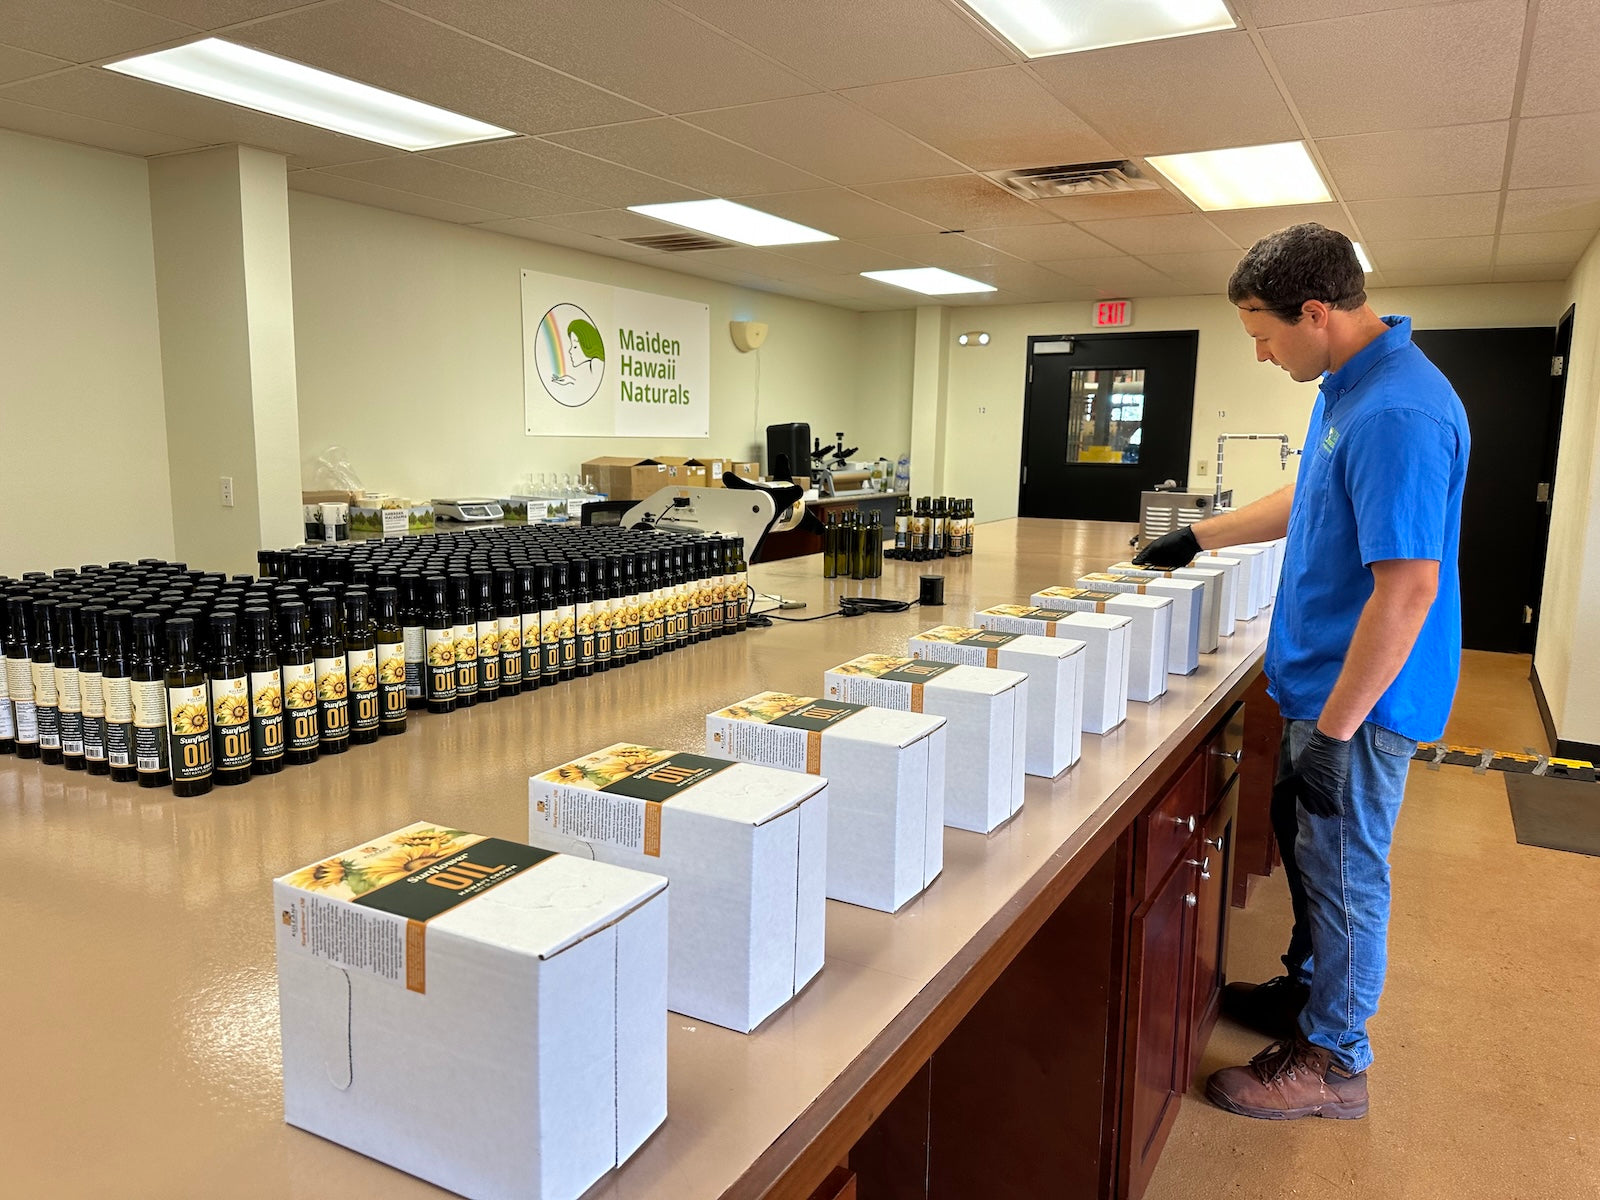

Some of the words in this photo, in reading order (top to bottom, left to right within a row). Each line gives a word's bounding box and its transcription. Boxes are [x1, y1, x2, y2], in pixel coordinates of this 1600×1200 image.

[1098, 302, 1127, 325] EXIT
[619, 328, 680, 356] Maiden
[621, 354, 676, 380] Hawaii
[621, 380, 690, 405] Naturals
[435, 672, 456, 692] OIL
[296, 714, 318, 738] OIL
[802, 707, 845, 720] OIL
[184, 740, 212, 768] OIL
[225, 731, 251, 757] OIL
[648, 766, 704, 784] OIL
[406, 852, 468, 884] Sunflower
[426, 862, 506, 890] OIL
